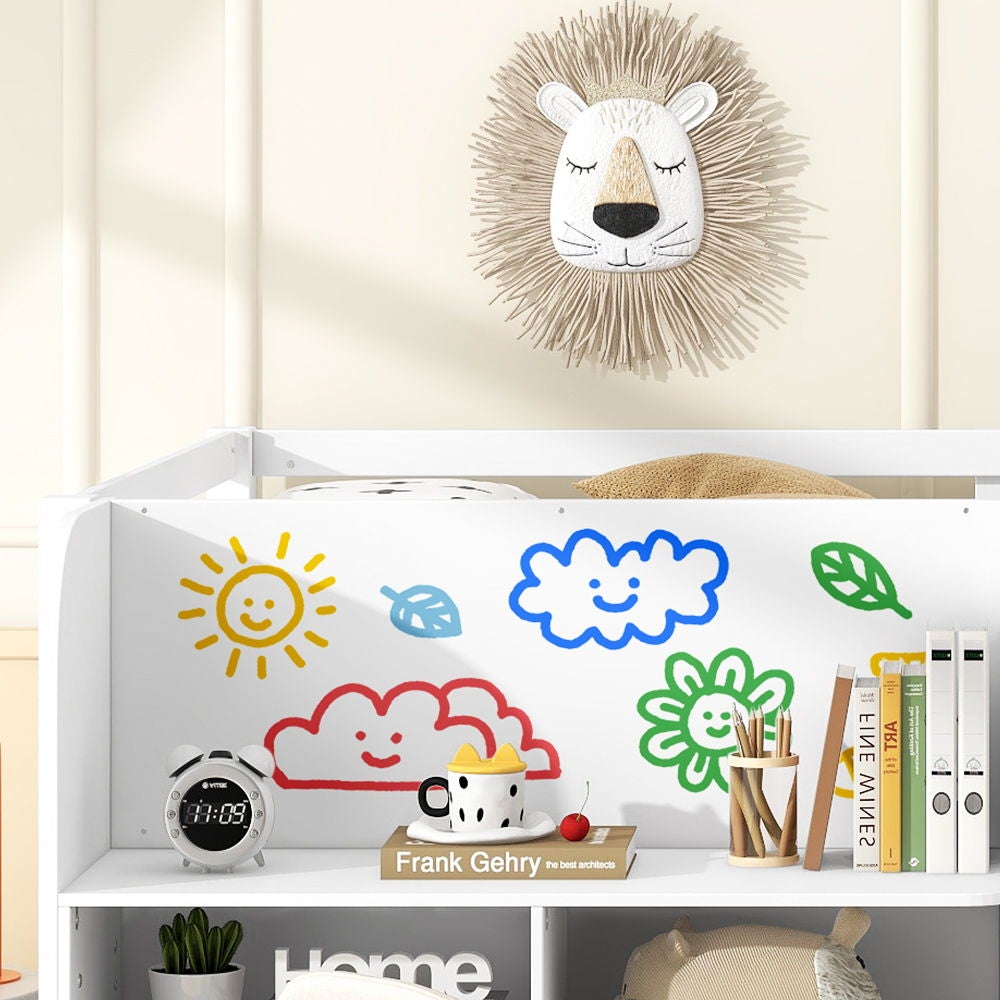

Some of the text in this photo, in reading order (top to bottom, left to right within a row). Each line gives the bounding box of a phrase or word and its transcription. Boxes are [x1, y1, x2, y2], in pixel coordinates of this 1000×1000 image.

[396, 850, 616, 878] Frank Gehry the best architects
